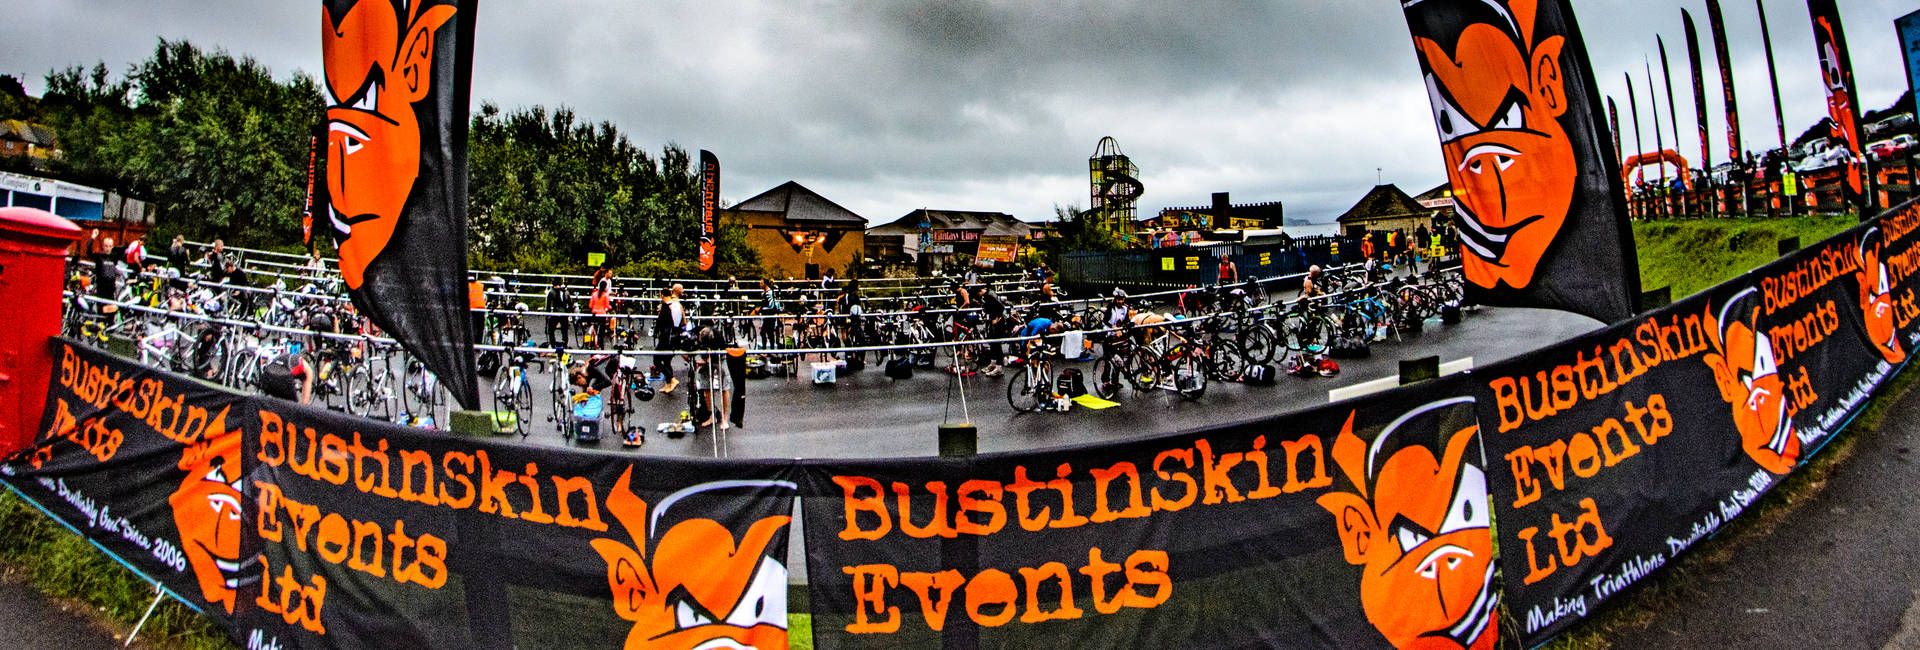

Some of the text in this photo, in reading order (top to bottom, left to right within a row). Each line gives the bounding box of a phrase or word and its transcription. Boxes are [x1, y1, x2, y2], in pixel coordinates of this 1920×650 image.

[1761, 243, 1857, 316] BustinSkin
[1489, 313, 1708, 433] BustinSkin
[1768, 300, 1839, 367] Events
[257, 410, 608, 532] BustinSkin
[832, 434, 1333, 541] BustinSkin
[1504, 394, 1673, 508] Events
[152, 537, 186, 572] 2006
[255, 481, 448, 589] Events
[1517, 497, 1614, 586] Ltd
[842, 547, 1173, 634] Events
[1527, 595, 1588, 634] Making
[1590, 553, 1667, 600] Triathlons
